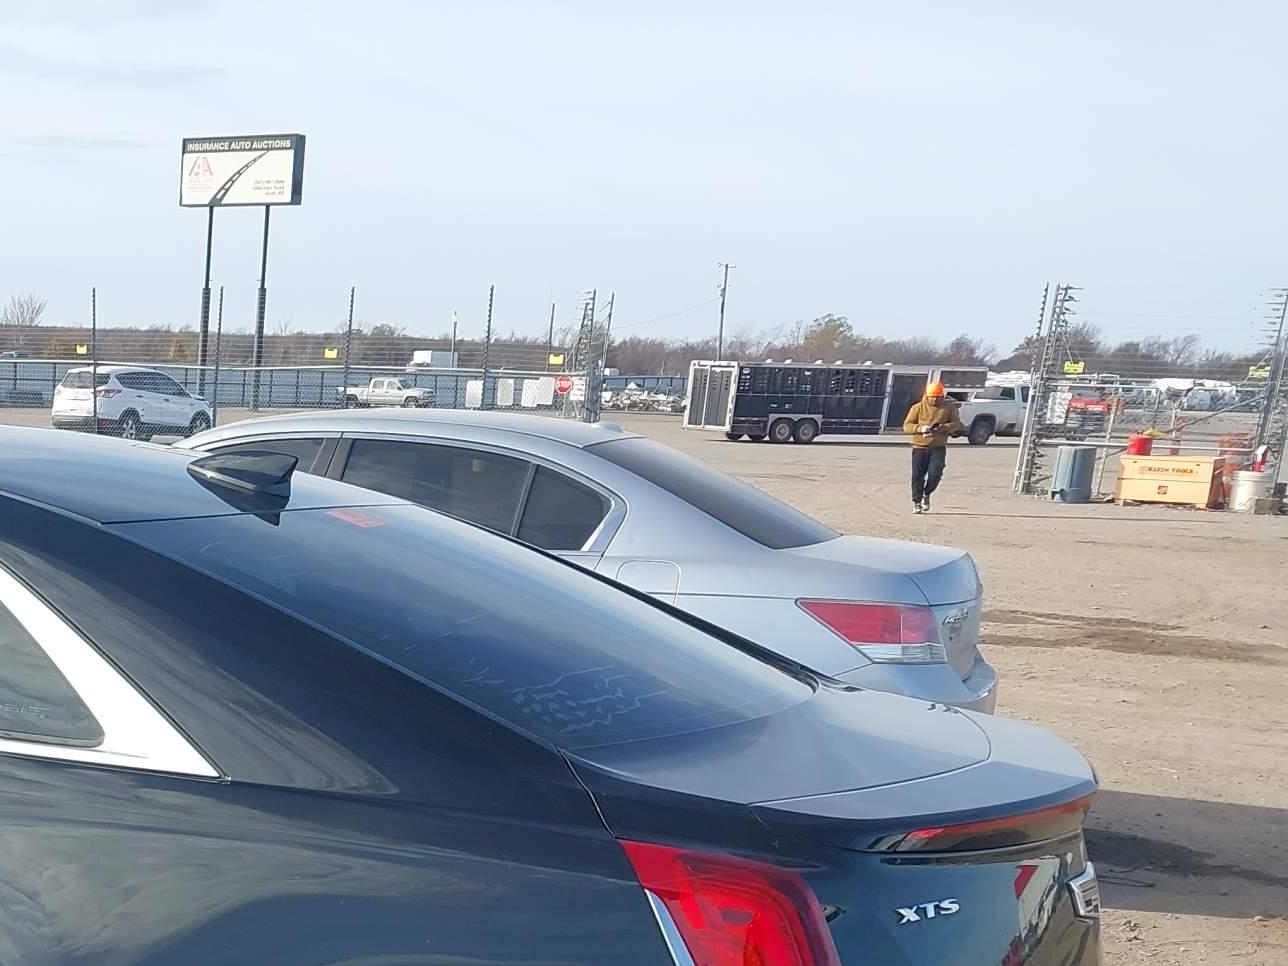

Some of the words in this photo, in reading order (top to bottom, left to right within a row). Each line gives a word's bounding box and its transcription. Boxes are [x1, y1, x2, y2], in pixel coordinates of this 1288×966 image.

[187, 142, 229, 151] INSURANCE
[230, 141, 251, 150] AUTO
[252, 140, 291, 149] AUCTIONS
[895, 898, 960, 925] XTS
